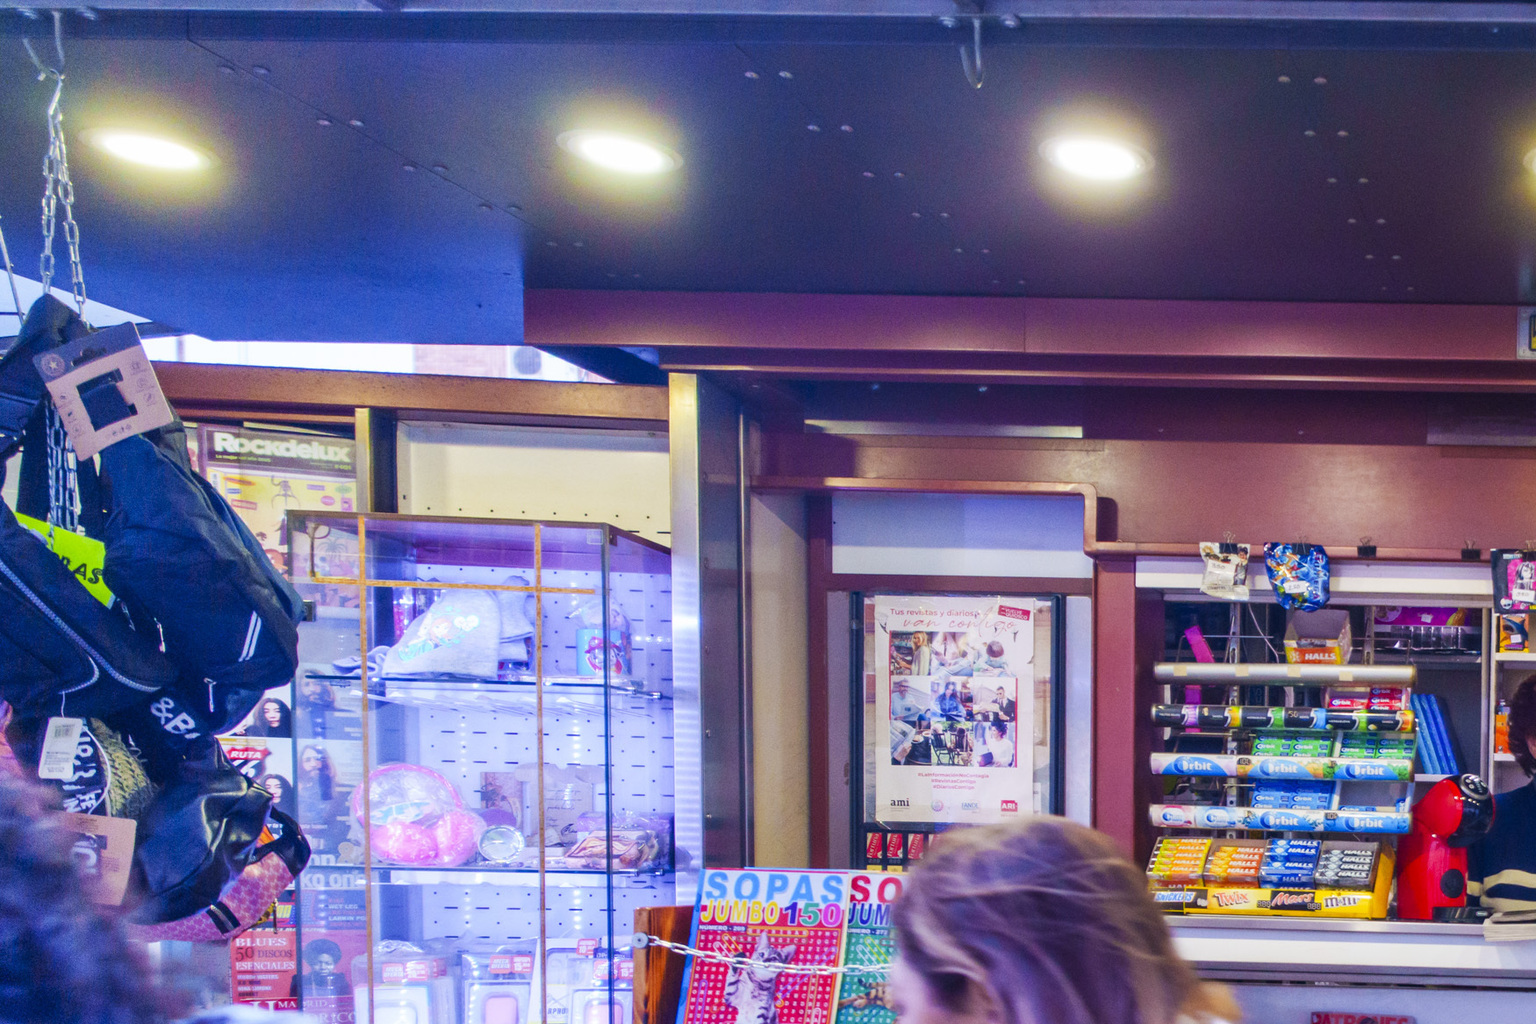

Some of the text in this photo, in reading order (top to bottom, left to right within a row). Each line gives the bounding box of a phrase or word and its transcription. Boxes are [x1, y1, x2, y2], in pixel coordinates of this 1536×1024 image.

[213, 431, 351, 463] Rockdelux
[890, 608, 905, 616] Tus
[906, 608, 938, 616] revistas
[1305, 652, 1336, 661] HALLS
[230, 749, 262, 760] RUTA
[1178, 758, 1212, 772] Orbit
[889, 798, 910, 807] ami
[705, 871, 844, 903] SOPAS
[1154, 891, 1197, 902] SNICKERS
[1214, 892, 1249, 907] Twix
[1272, 892, 1314, 906] Mars
[700, 899, 843, 927] JUMBO 150
[848, 902, 891, 927] JUM
[235, 937, 288, 947] BLUES
[235, 947, 293, 961] 50 DISCOS
[235, 961, 295, 971] ESENCIALES
